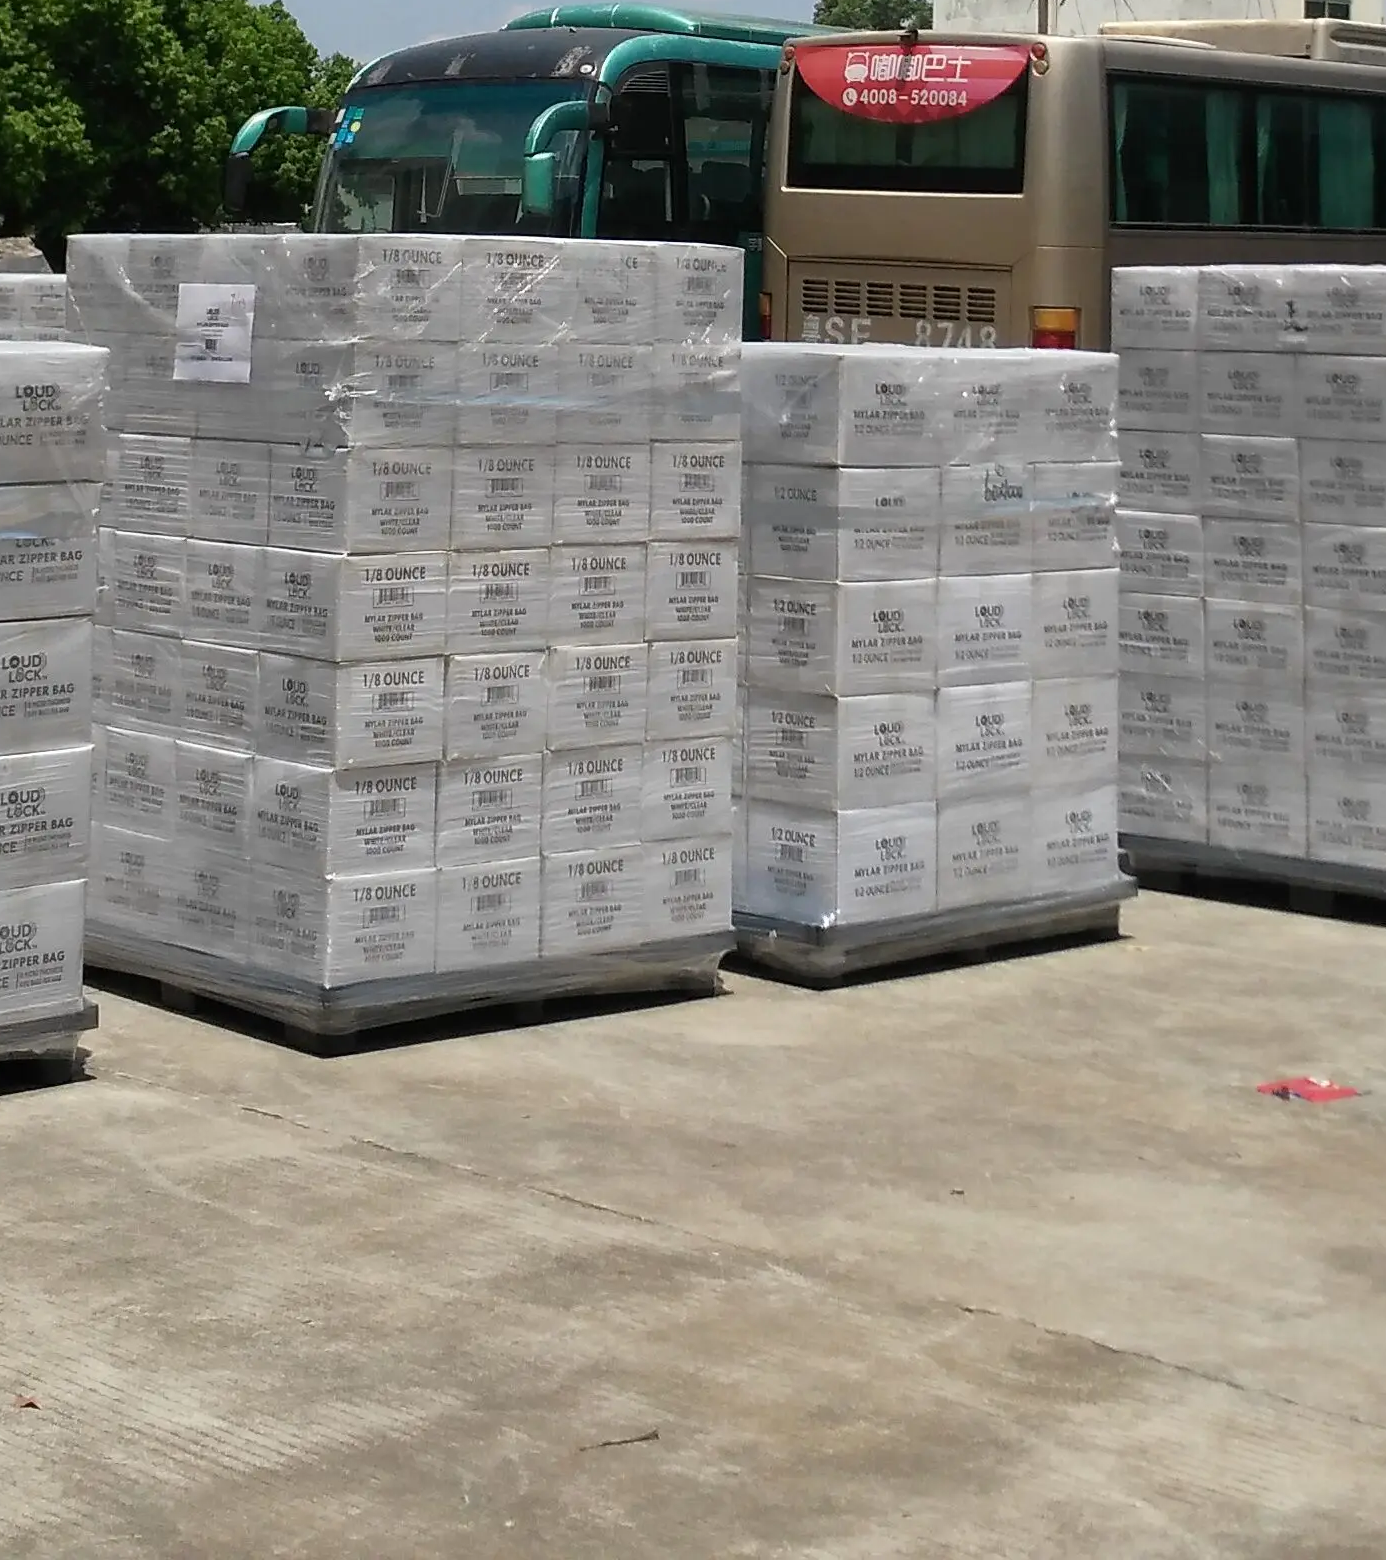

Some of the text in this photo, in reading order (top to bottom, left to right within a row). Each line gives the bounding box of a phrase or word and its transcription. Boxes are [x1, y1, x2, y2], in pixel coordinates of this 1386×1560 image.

[860, 89, 967, 106] 4008-520084
[595, 457, 631, 469] OUNCE
[472, 564, 529, 576] 1/8 OUNCE
[572, 558, 625, 571] 1/8 OUNCE
[364, 568, 425, 582] 1/8 OUNCE
[1, 654, 42, 670] LOUD
[575, 657, 631, 670] 1/8 OUNCE
[9, 667, 42, 682] LOCK
[363, 672, 424, 688] 1/8 OUNCE
[474, 666, 529, 681] 1/8 OUNCE
[12, 686, 49, 698] ZIPPER
[52, 683, 74, 695] BAG
[662, 748, 715, 762] 1/8 OUNCE
[567, 759, 622, 775] 1/8 OUNCE
[464, 769, 522, 784] 1/8 OUNCE
[568, 860, 624, 877] 1/8 OUNCE
[2, 956, 40, 971] ZIPPER
[43, 951, 65, 964] BAG
